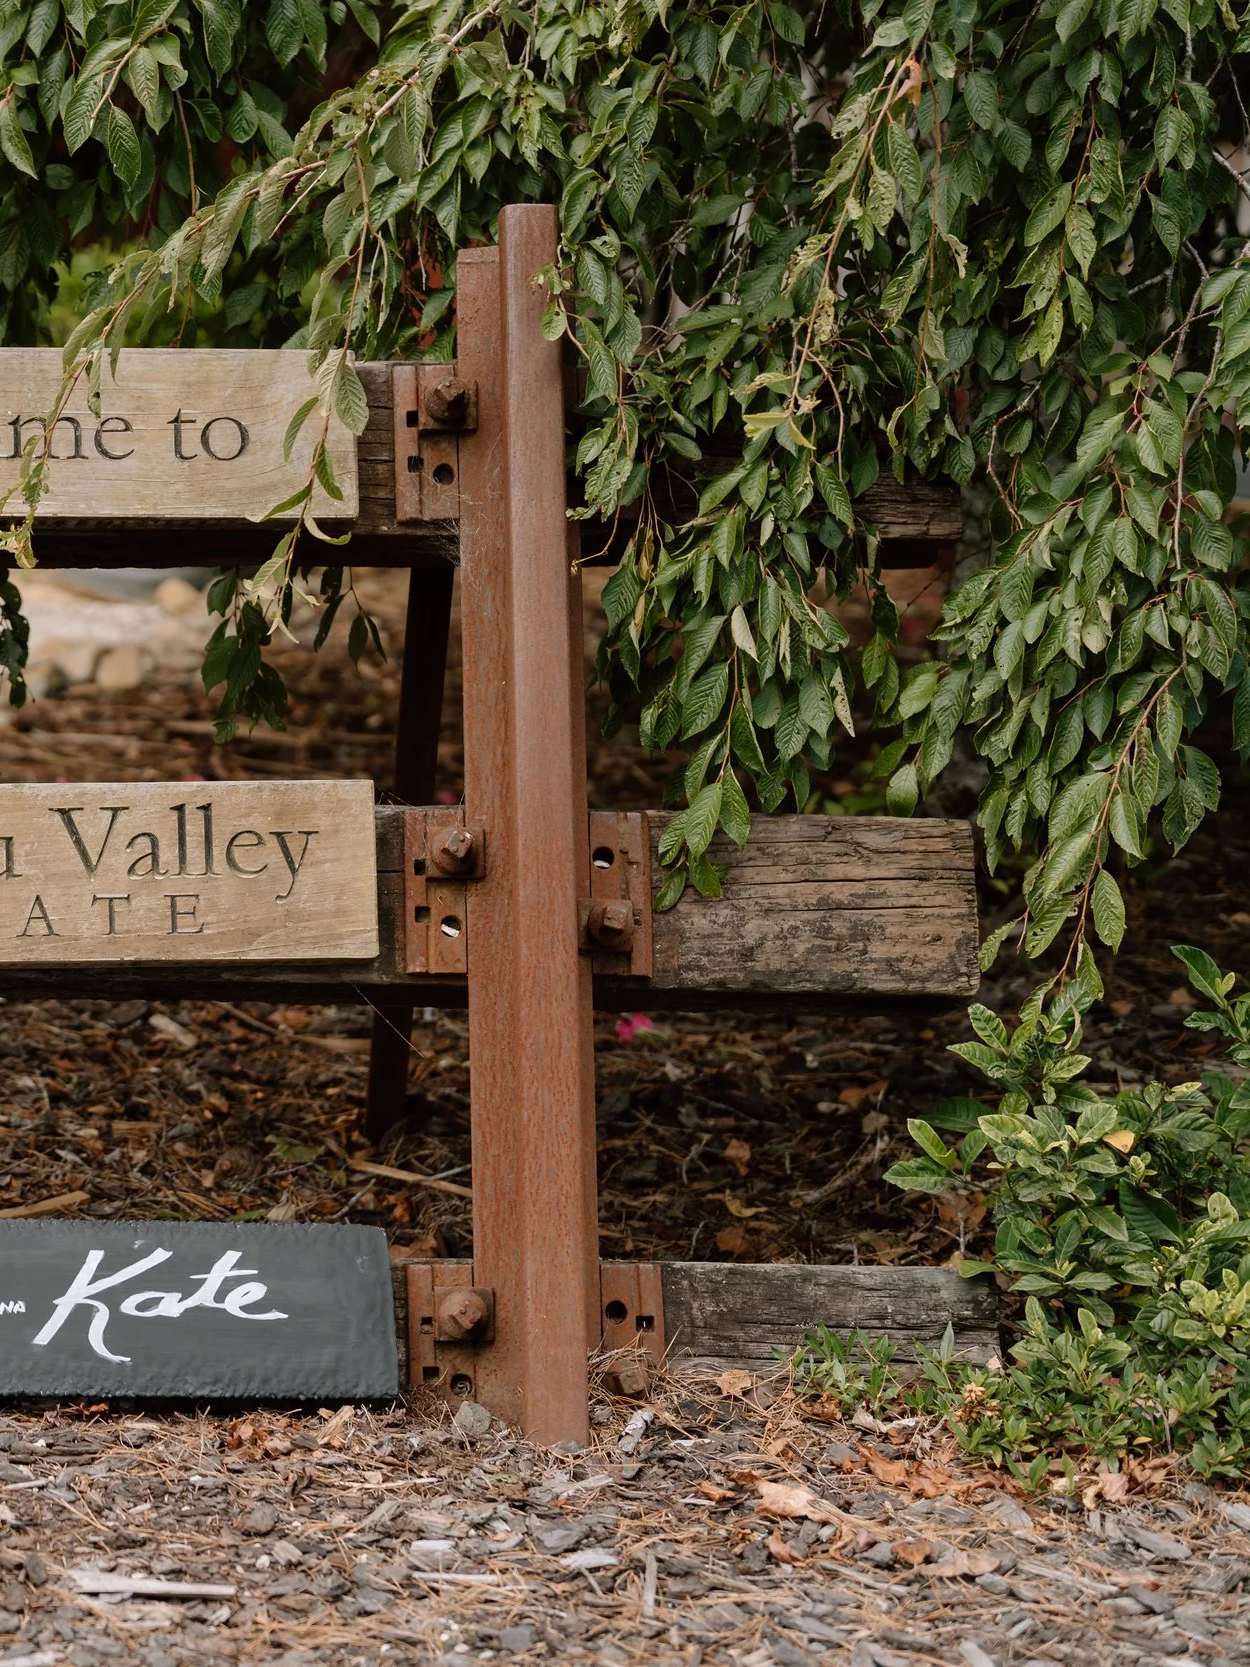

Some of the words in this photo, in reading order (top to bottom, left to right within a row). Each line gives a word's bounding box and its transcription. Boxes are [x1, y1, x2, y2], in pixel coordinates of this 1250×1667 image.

[166, 408, 251, 461] to
[48, 802, 320, 904] Valley
[31, 1246, 289, 1365] Kate
